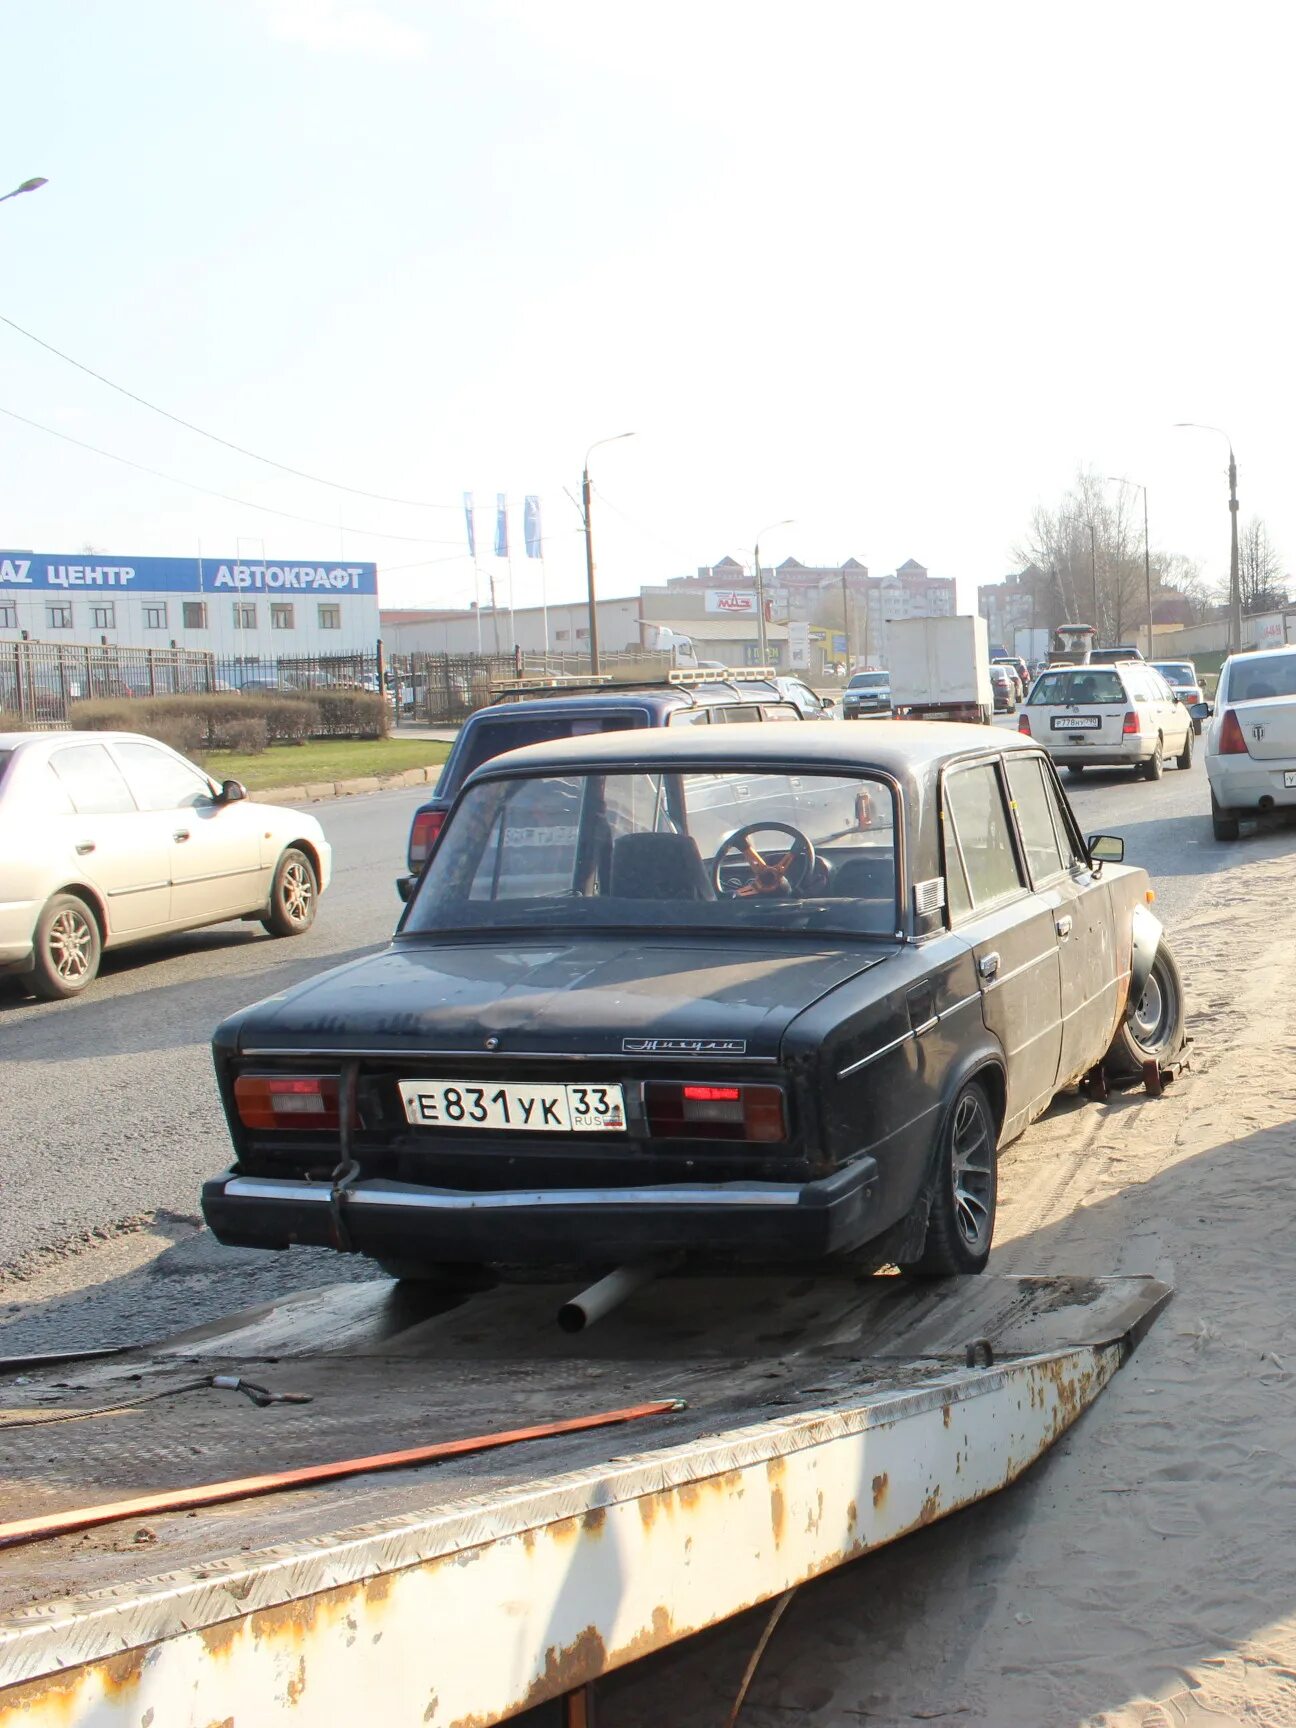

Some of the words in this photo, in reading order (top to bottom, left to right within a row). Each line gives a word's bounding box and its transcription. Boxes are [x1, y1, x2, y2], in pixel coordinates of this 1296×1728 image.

[0, 560, 32, 583] AZ
[47, 565, 136, 588] ЦЕНТР
[214, 565, 363, 588] АВТОКРАФТ
[416, 1087, 562, 1125] Е831УК
[572, 1088, 610, 1115] 33
[574, 1116, 602, 1126] RUS
